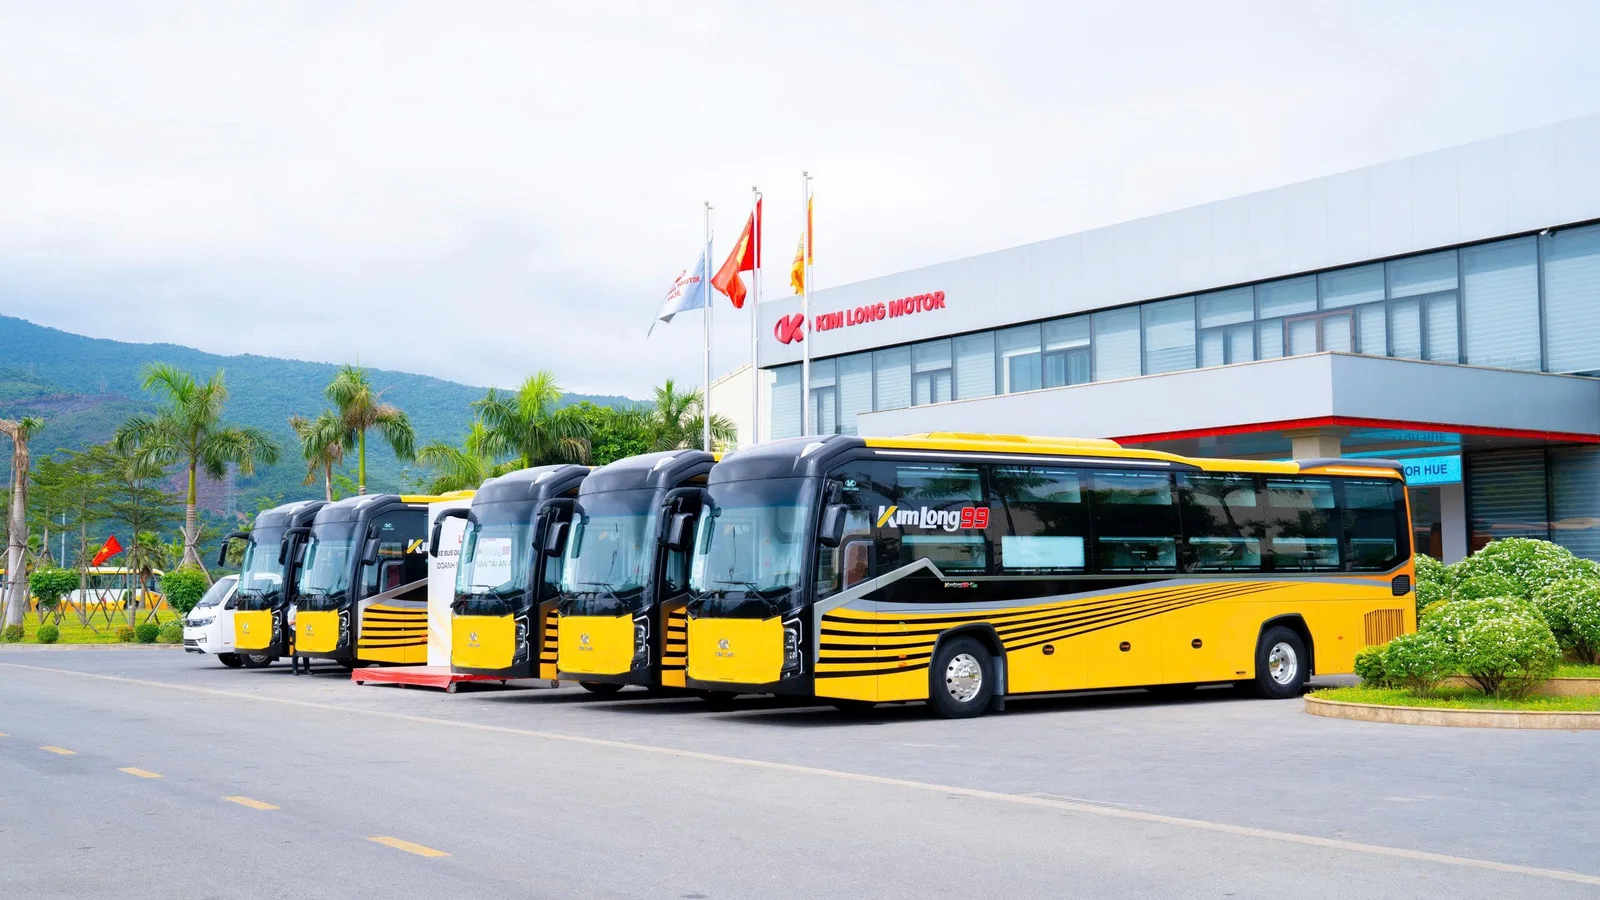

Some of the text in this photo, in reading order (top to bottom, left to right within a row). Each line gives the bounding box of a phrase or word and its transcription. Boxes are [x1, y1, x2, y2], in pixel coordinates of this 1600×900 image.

[815, 310, 844, 332] KIM
[846, 302, 886, 326] LONG
[888, 290, 946, 318] MOTOR
[1404, 464, 1448, 477] OR HUE
